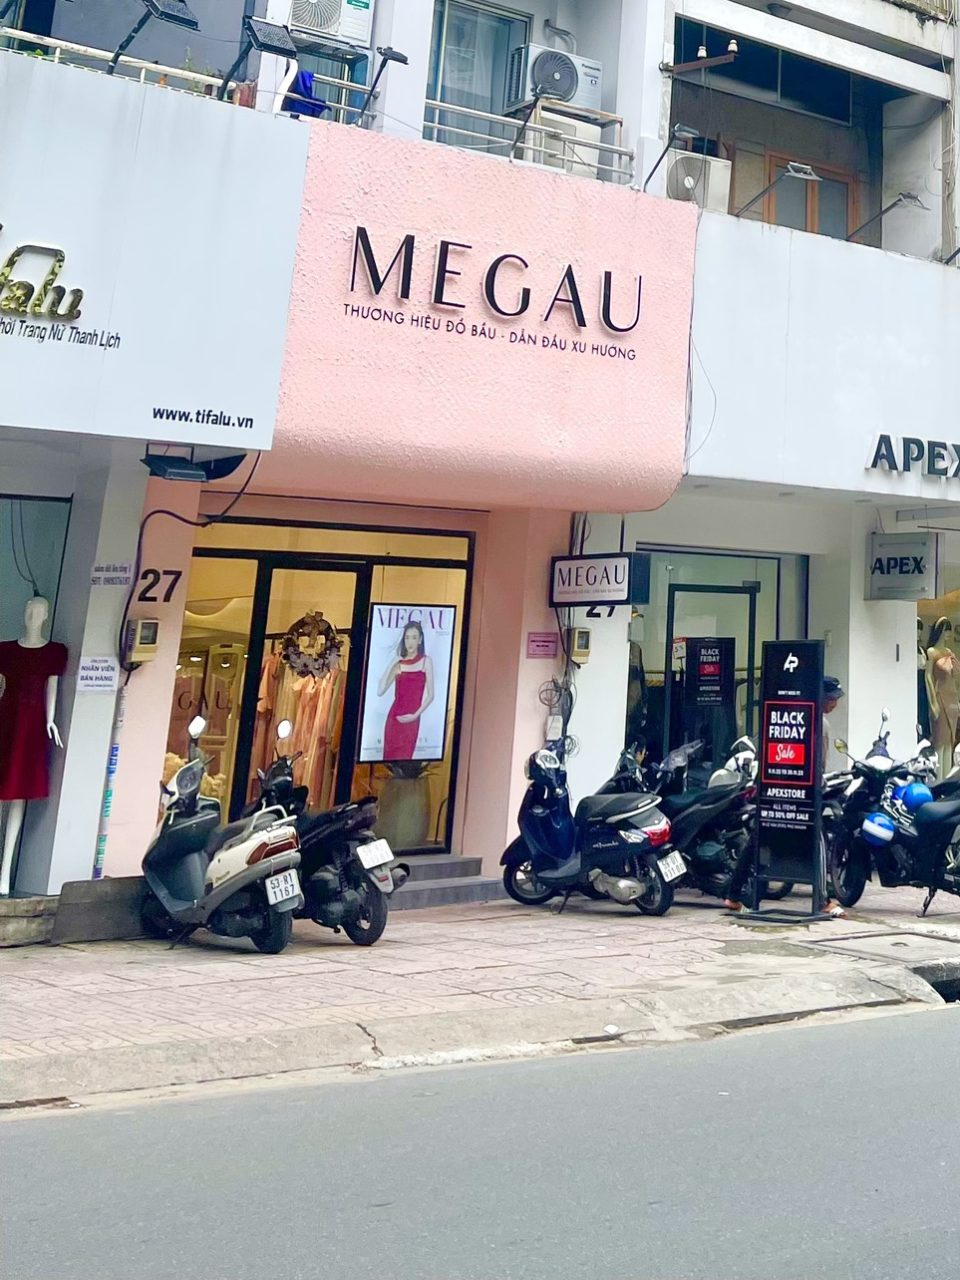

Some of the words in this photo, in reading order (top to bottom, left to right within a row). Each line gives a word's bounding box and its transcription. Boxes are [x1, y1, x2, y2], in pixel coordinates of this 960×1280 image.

[350, 225, 642, 333] MEGAU
[19, 320, 47, 343] Trang
[68, 326, 98, 346] Thanh
[99, 330, 121, 351] Lịch
[343, 303, 405, 325] THƯƠNG
[410, 315, 441, 331] HIỆU
[572, 340, 587, 354] XU
[152, 407, 254, 429] www.tifalu.vn
[871, 556, 925, 575] APEX
[558, 564, 626, 587] MEGAU
[138, 569, 182, 602] 27
[771, 711, 804, 725] BLACK
[769, 726, 806, 739] FRIDAY
[776, 744, 795, 762] Sale
[767, 788, 806, 799] APEXSTORE
[786, 812, 795, 820] OFF
[270, 872, 294, 890] 53-R1
[273, 885, 295, 902] 1167
